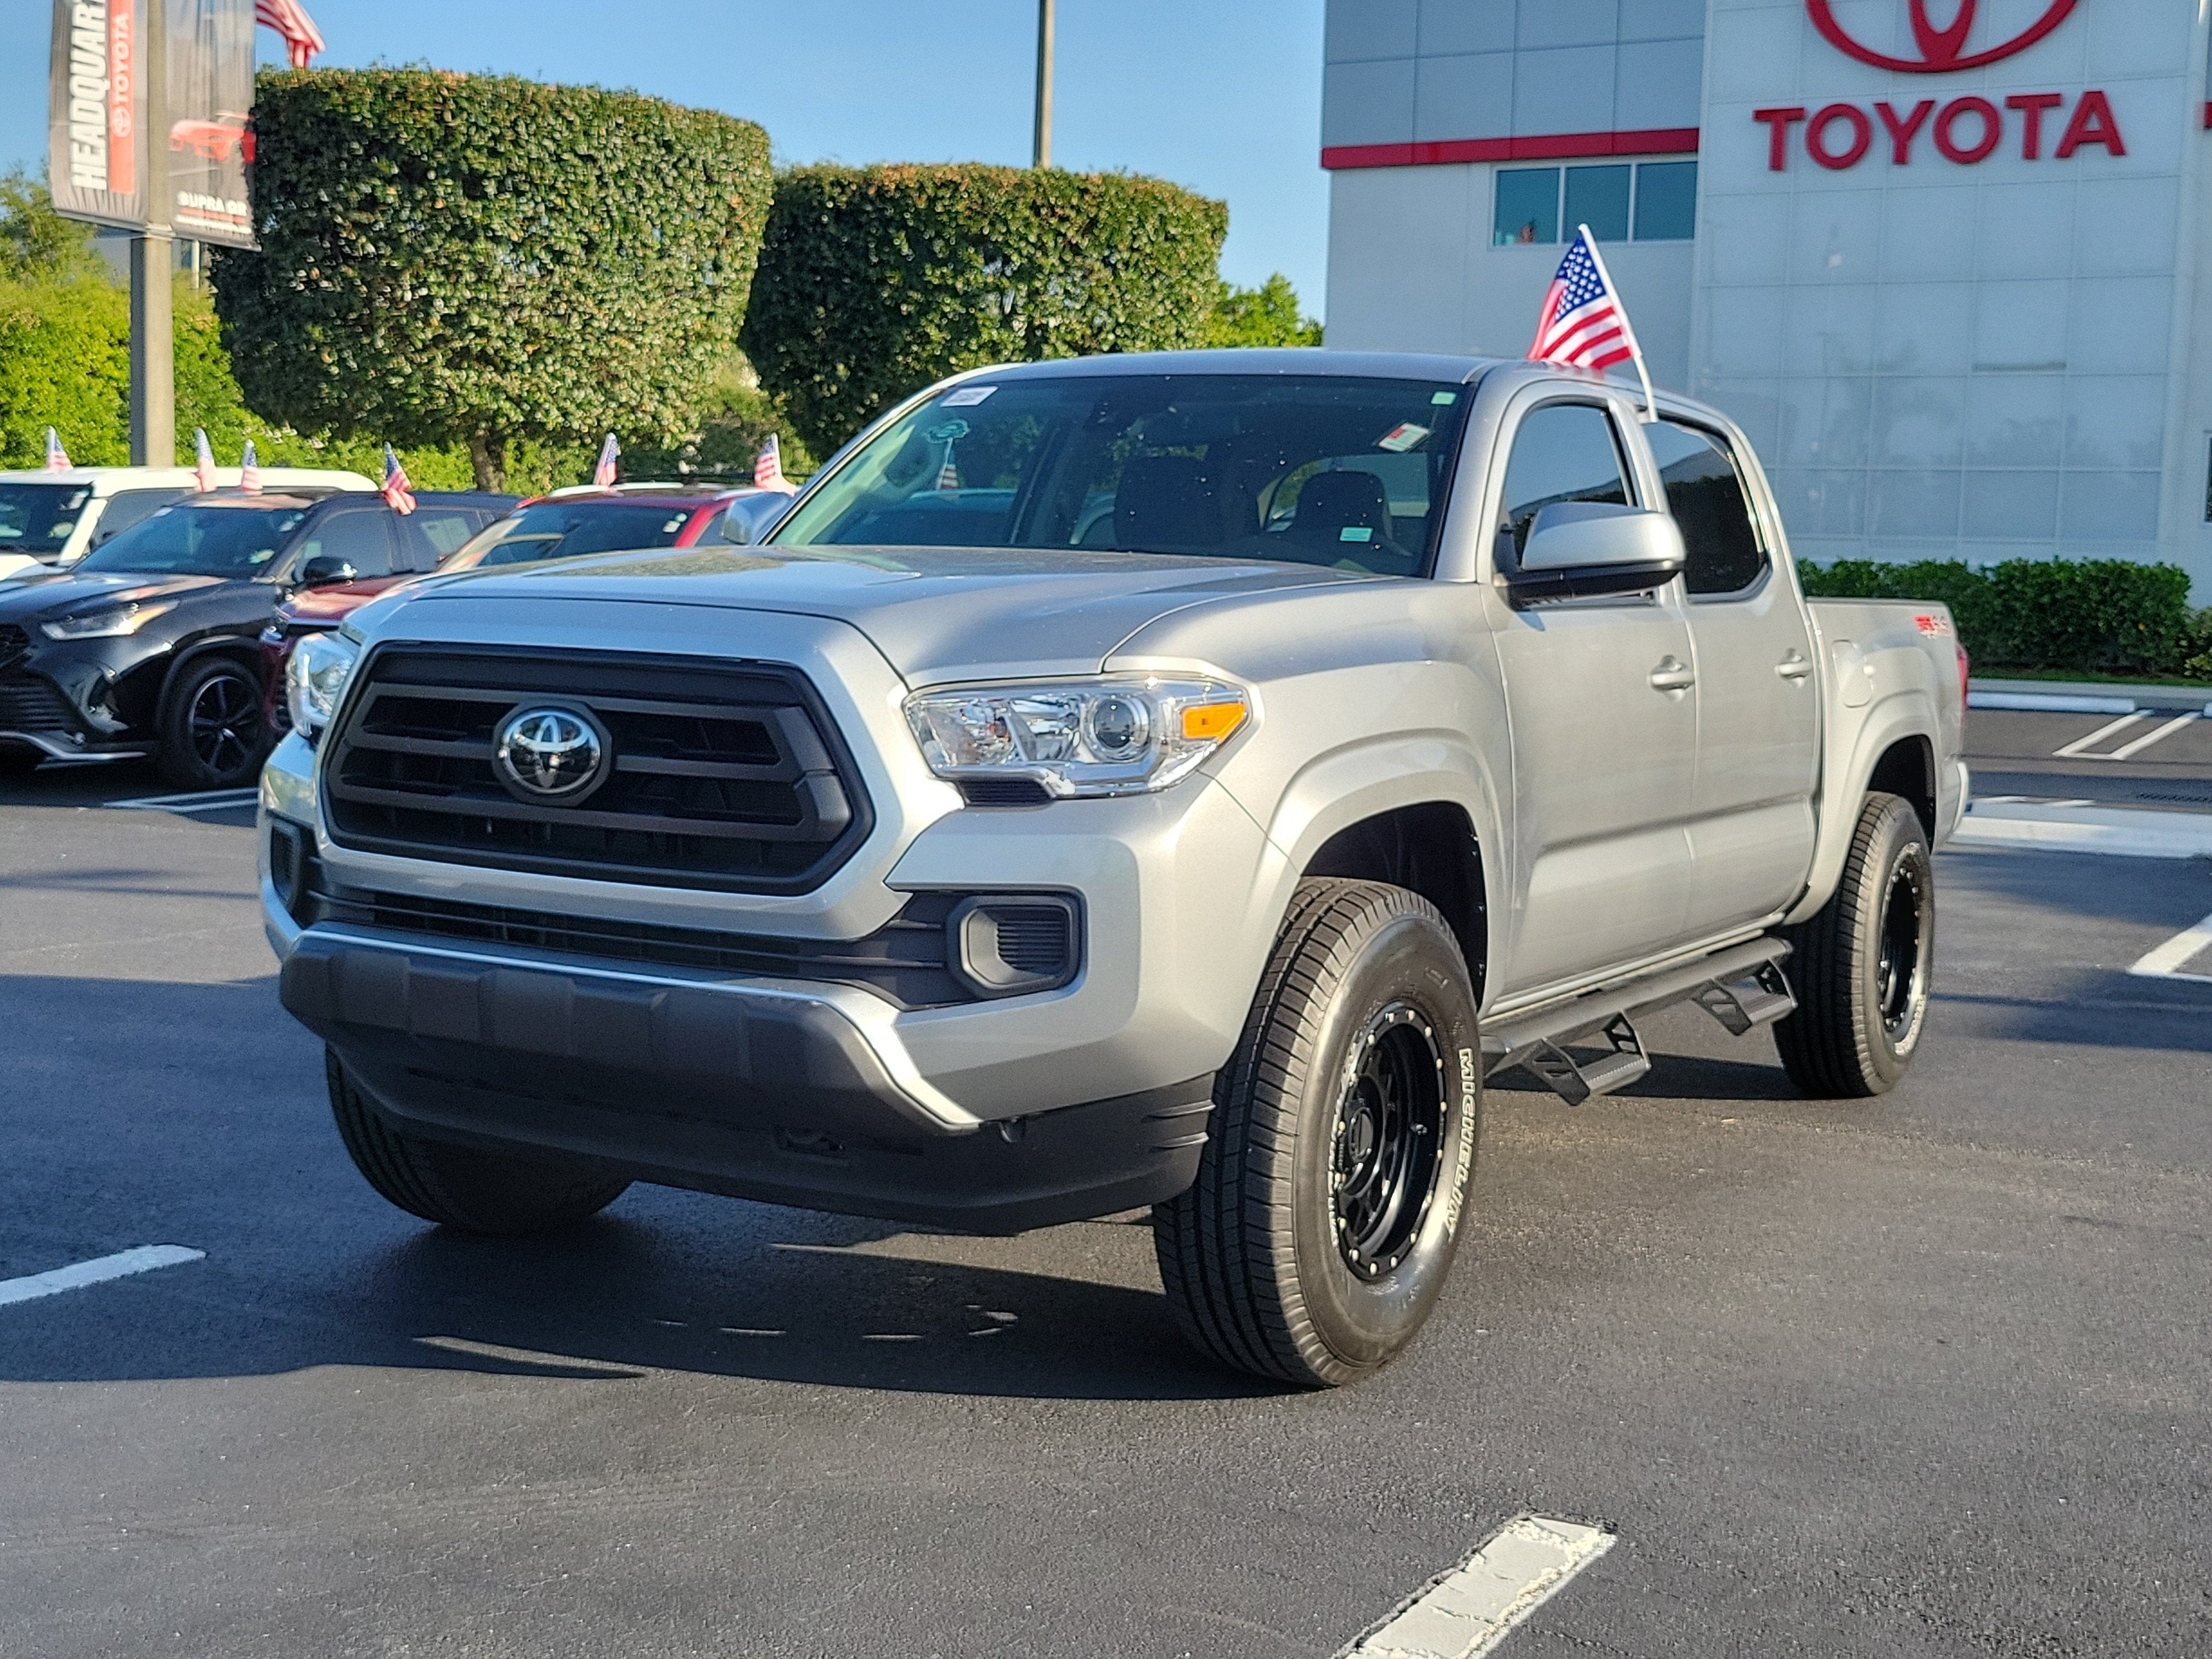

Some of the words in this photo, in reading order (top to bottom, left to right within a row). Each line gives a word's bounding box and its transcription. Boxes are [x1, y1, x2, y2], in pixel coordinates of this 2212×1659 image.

[114, 14, 129, 105] TOYOTA
[1752, 90, 2126, 171] TOYOTA
[177, 190, 224, 212] SUPRA
[1443, 1047, 1476, 1242] MICHELIN
